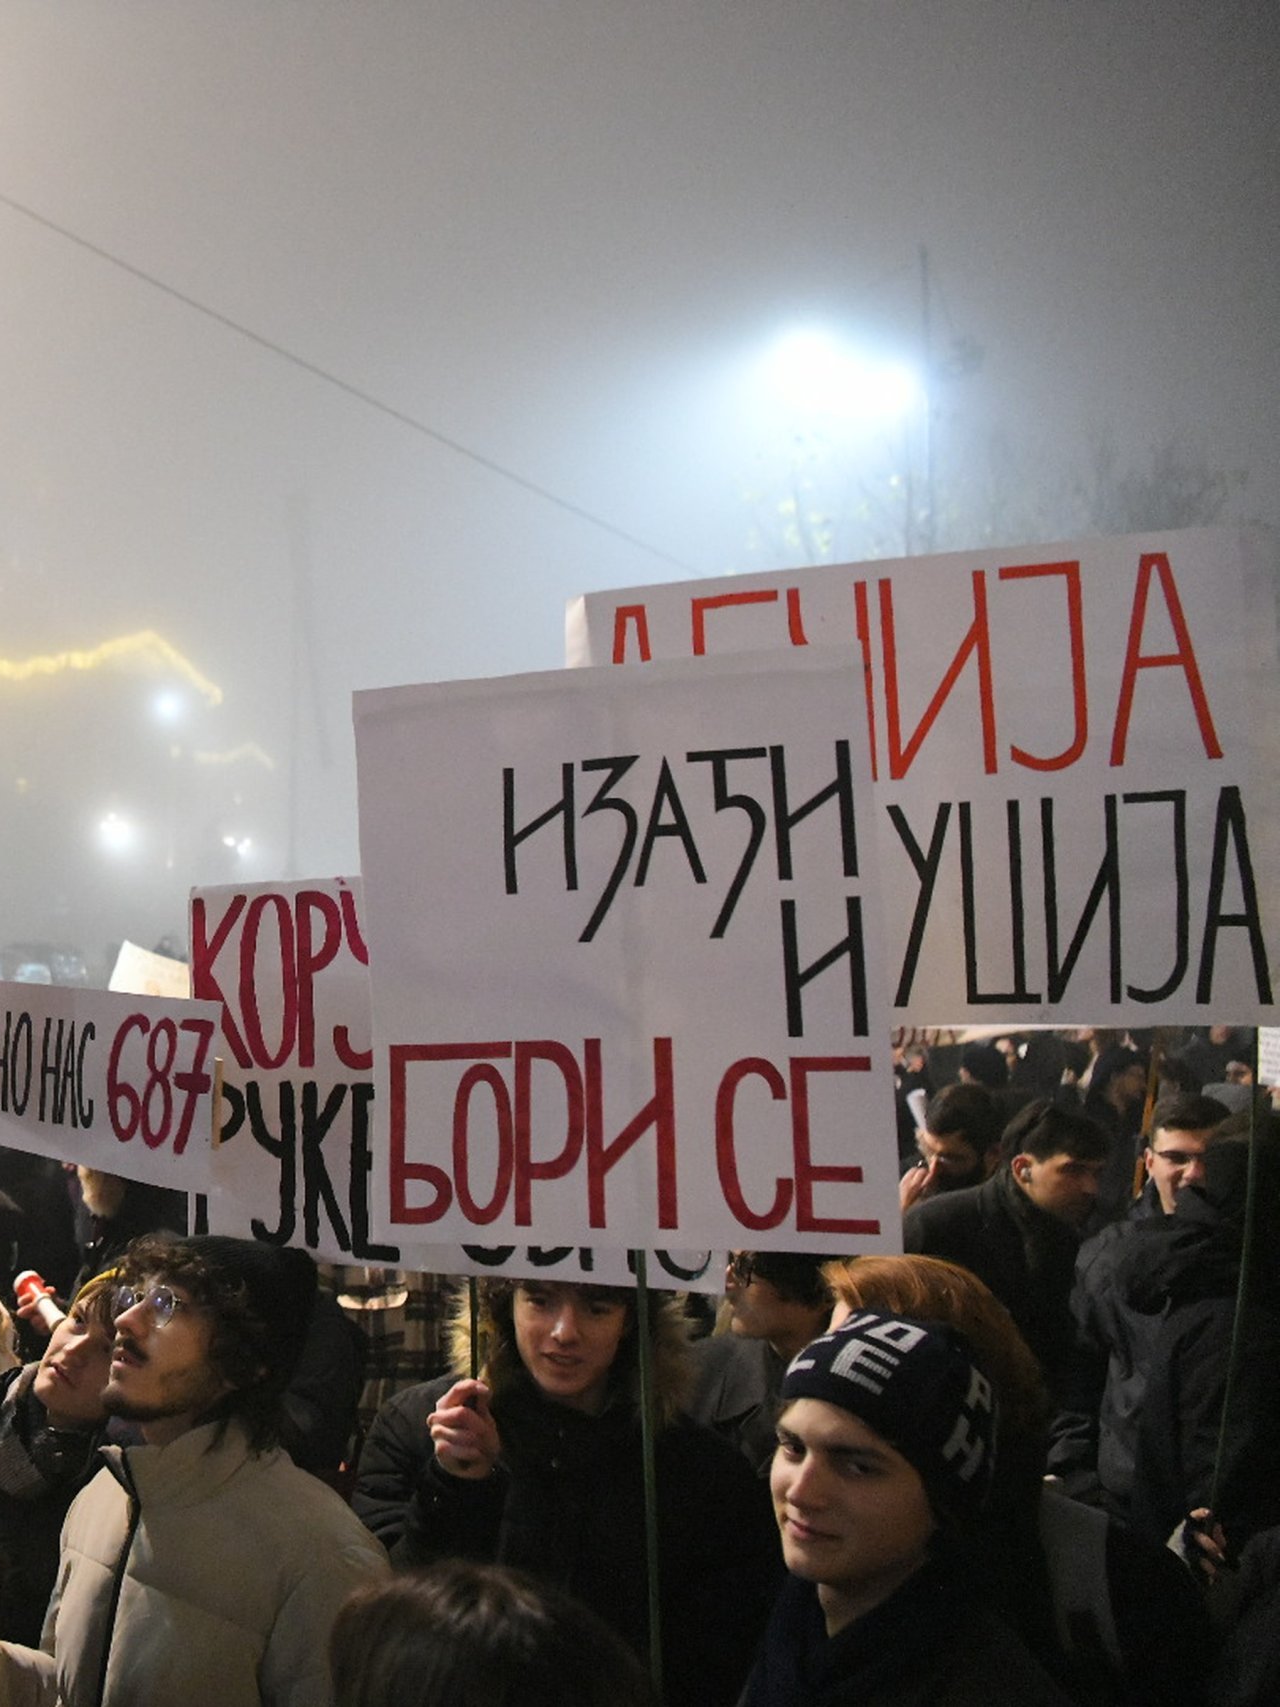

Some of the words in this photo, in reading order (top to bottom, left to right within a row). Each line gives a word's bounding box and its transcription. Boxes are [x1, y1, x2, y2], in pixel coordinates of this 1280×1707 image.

[502, 739, 859, 943] ИЗАЂИ
[780, 896, 869, 1038] И
[40, 1017, 96, 1129] НАС
[107, 1013, 217, 1156] 687
[389, 1037, 678, 1231] БОРИ
[715, 1056, 881, 1235] СЕ
